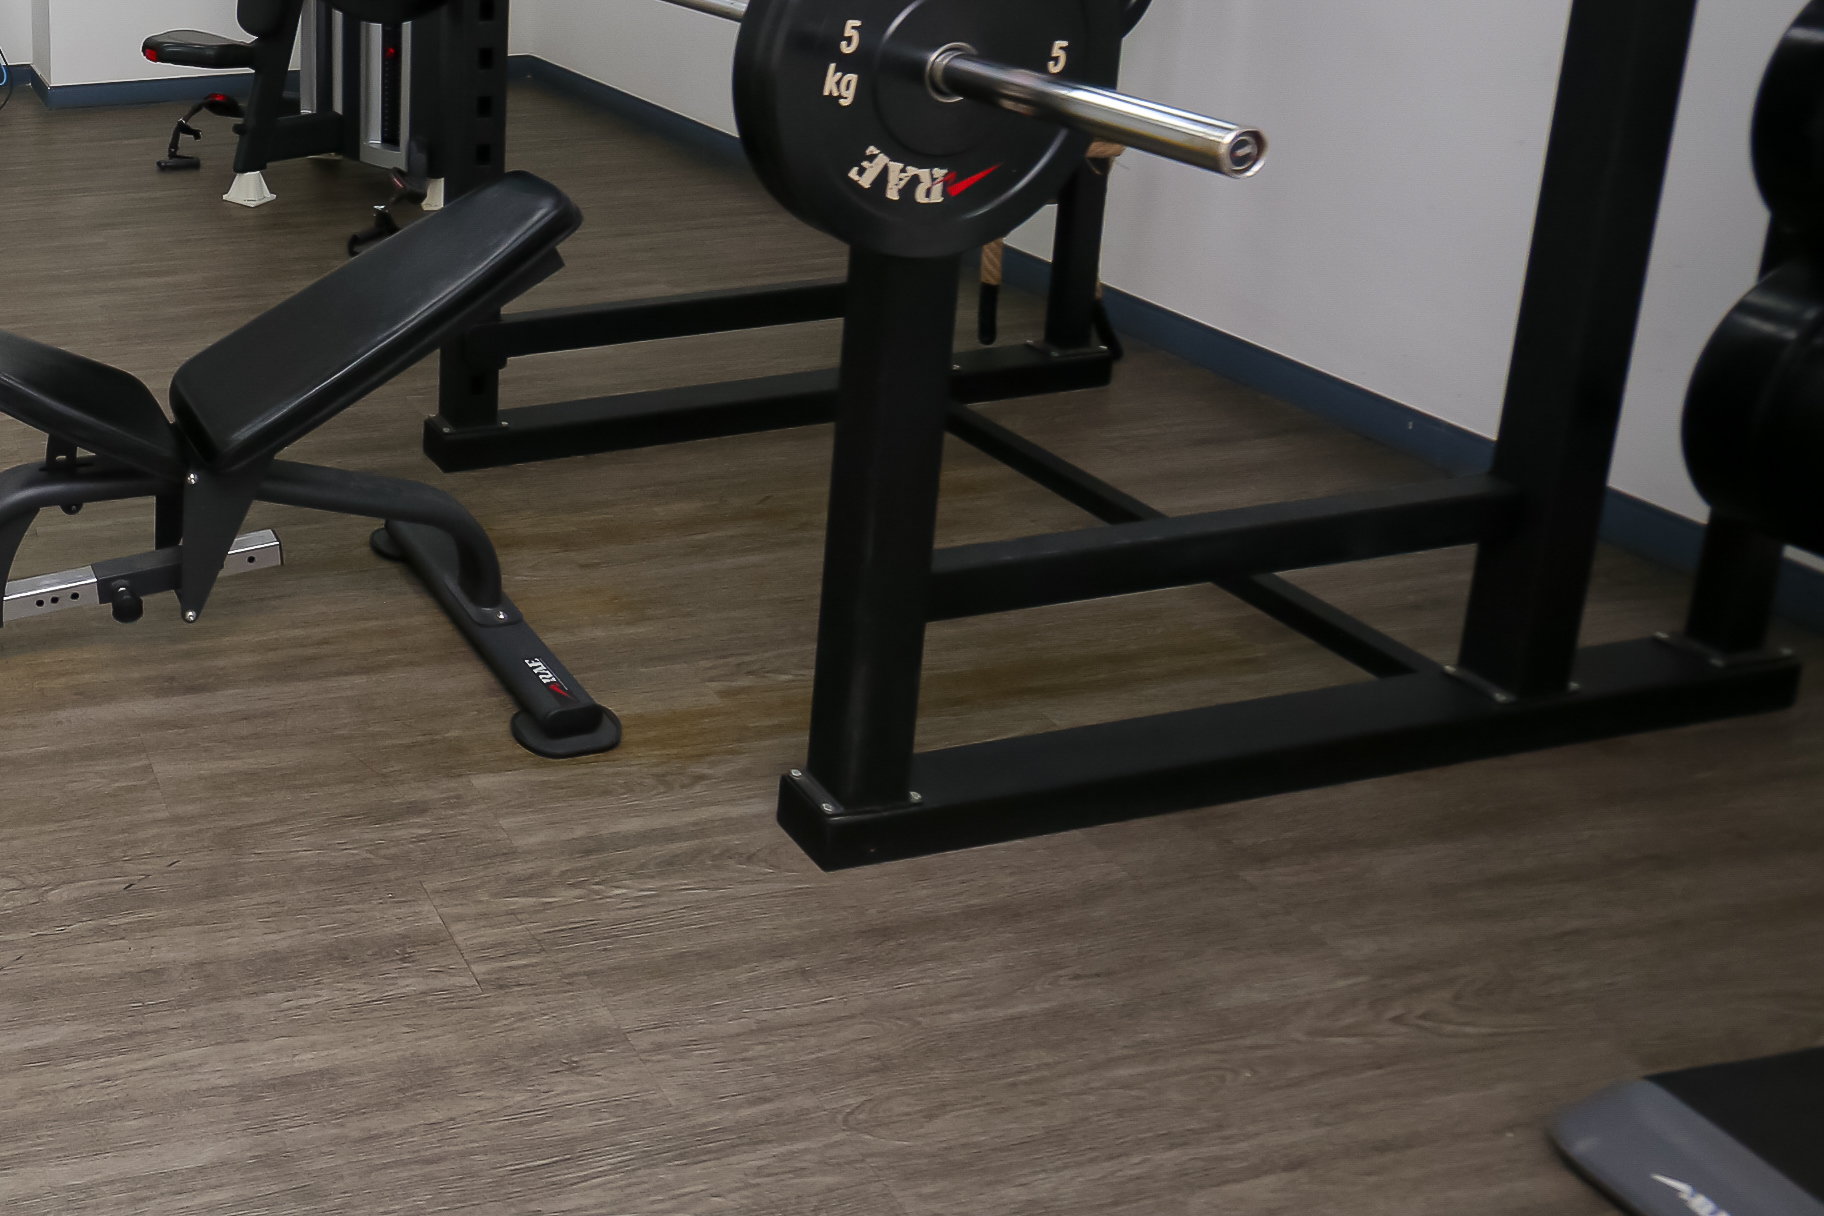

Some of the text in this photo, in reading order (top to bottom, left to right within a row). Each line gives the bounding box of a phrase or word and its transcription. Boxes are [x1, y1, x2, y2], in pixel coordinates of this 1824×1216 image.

[839, 19, 862, 54] 5
[1047, 40, 1069, 73] 5
[822, 62, 858, 106] kg
[847, 145, 949, 203] RAE
[524, 657, 557, 684] RAE
